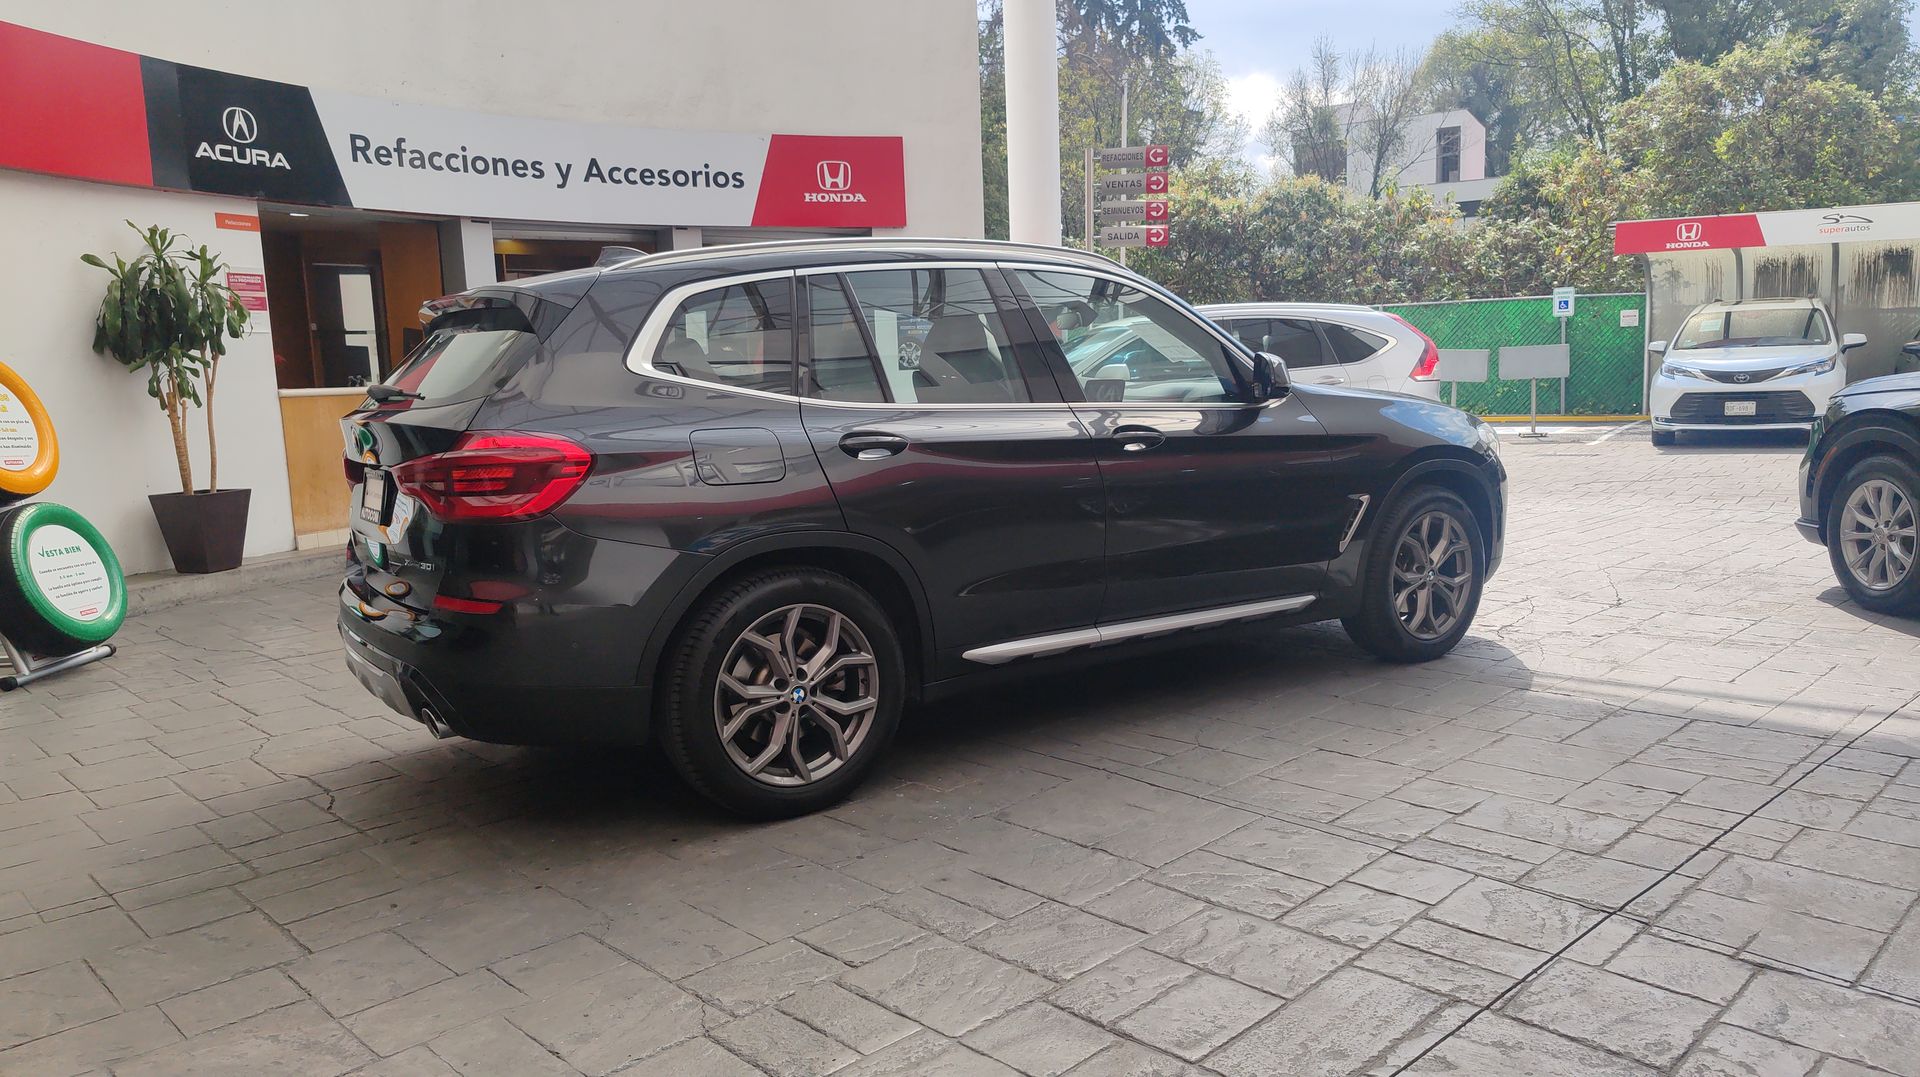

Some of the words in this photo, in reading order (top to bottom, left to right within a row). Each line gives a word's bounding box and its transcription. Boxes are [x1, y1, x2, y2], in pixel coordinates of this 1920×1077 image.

[195, 142, 291, 170] ACURA
[1102, 152, 1144, 161] REFACCIONES
[349, 133, 545, 180] Refacciones
[554, 161, 573, 189] y
[583, 157, 745, 190] Accesorios
[1105, 180, 1142, 189] VENTAS
[804, 192, 867, 203] HONDA
[1102, 206, 1144, 215] SEMINUEVOS
[1818, 224, 1871, 235] superautos
[1107, 232, 1140, 241] SALIDA
[1665, 240, 1710, 249] HONDA
[45, 548, 64, 558] ESTA
[64, 545, 81, 554] BIEN
